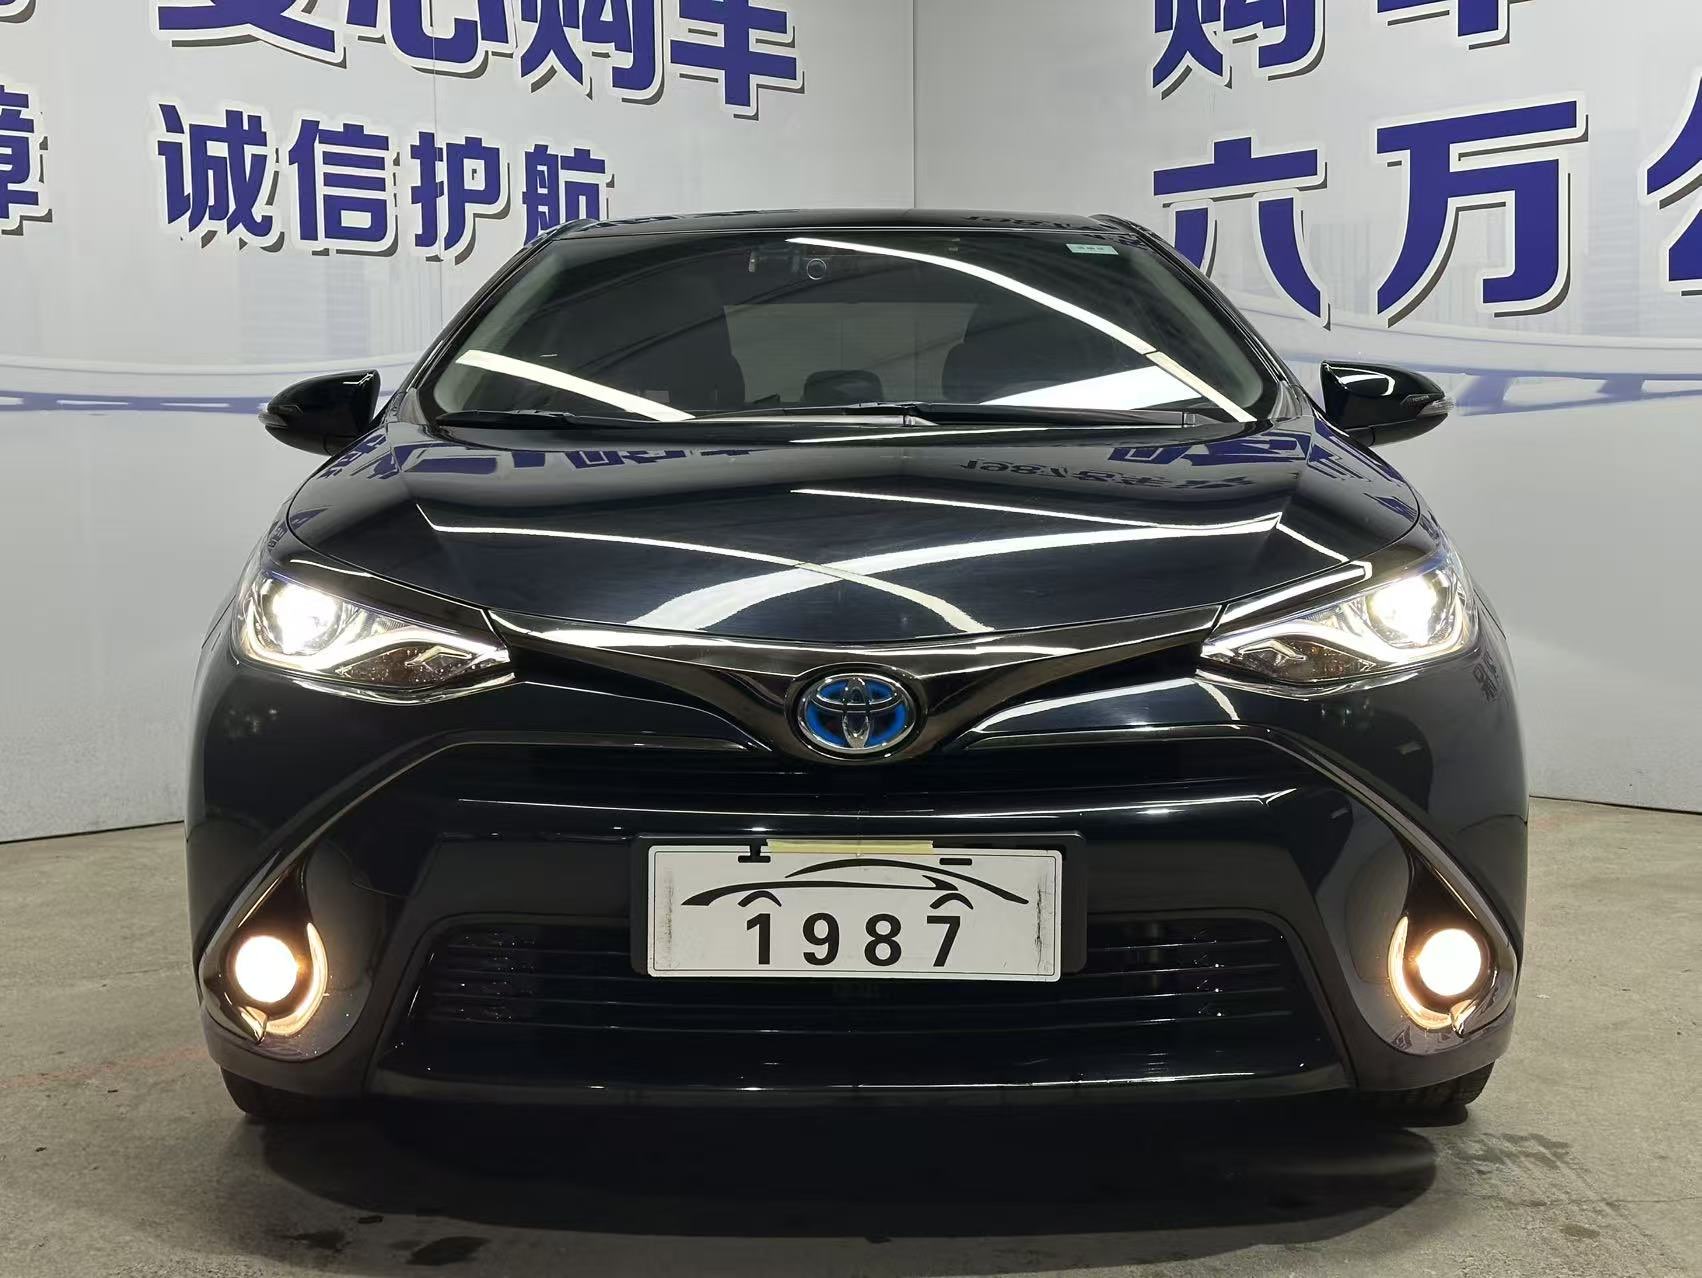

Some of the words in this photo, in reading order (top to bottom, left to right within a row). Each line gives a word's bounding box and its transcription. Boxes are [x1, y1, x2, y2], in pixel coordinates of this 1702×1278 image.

[157, 103, 608, 250] 诚信护航
[1153, 78, 1702, 318] 六万
[746, 912, 960, 967] 1987
